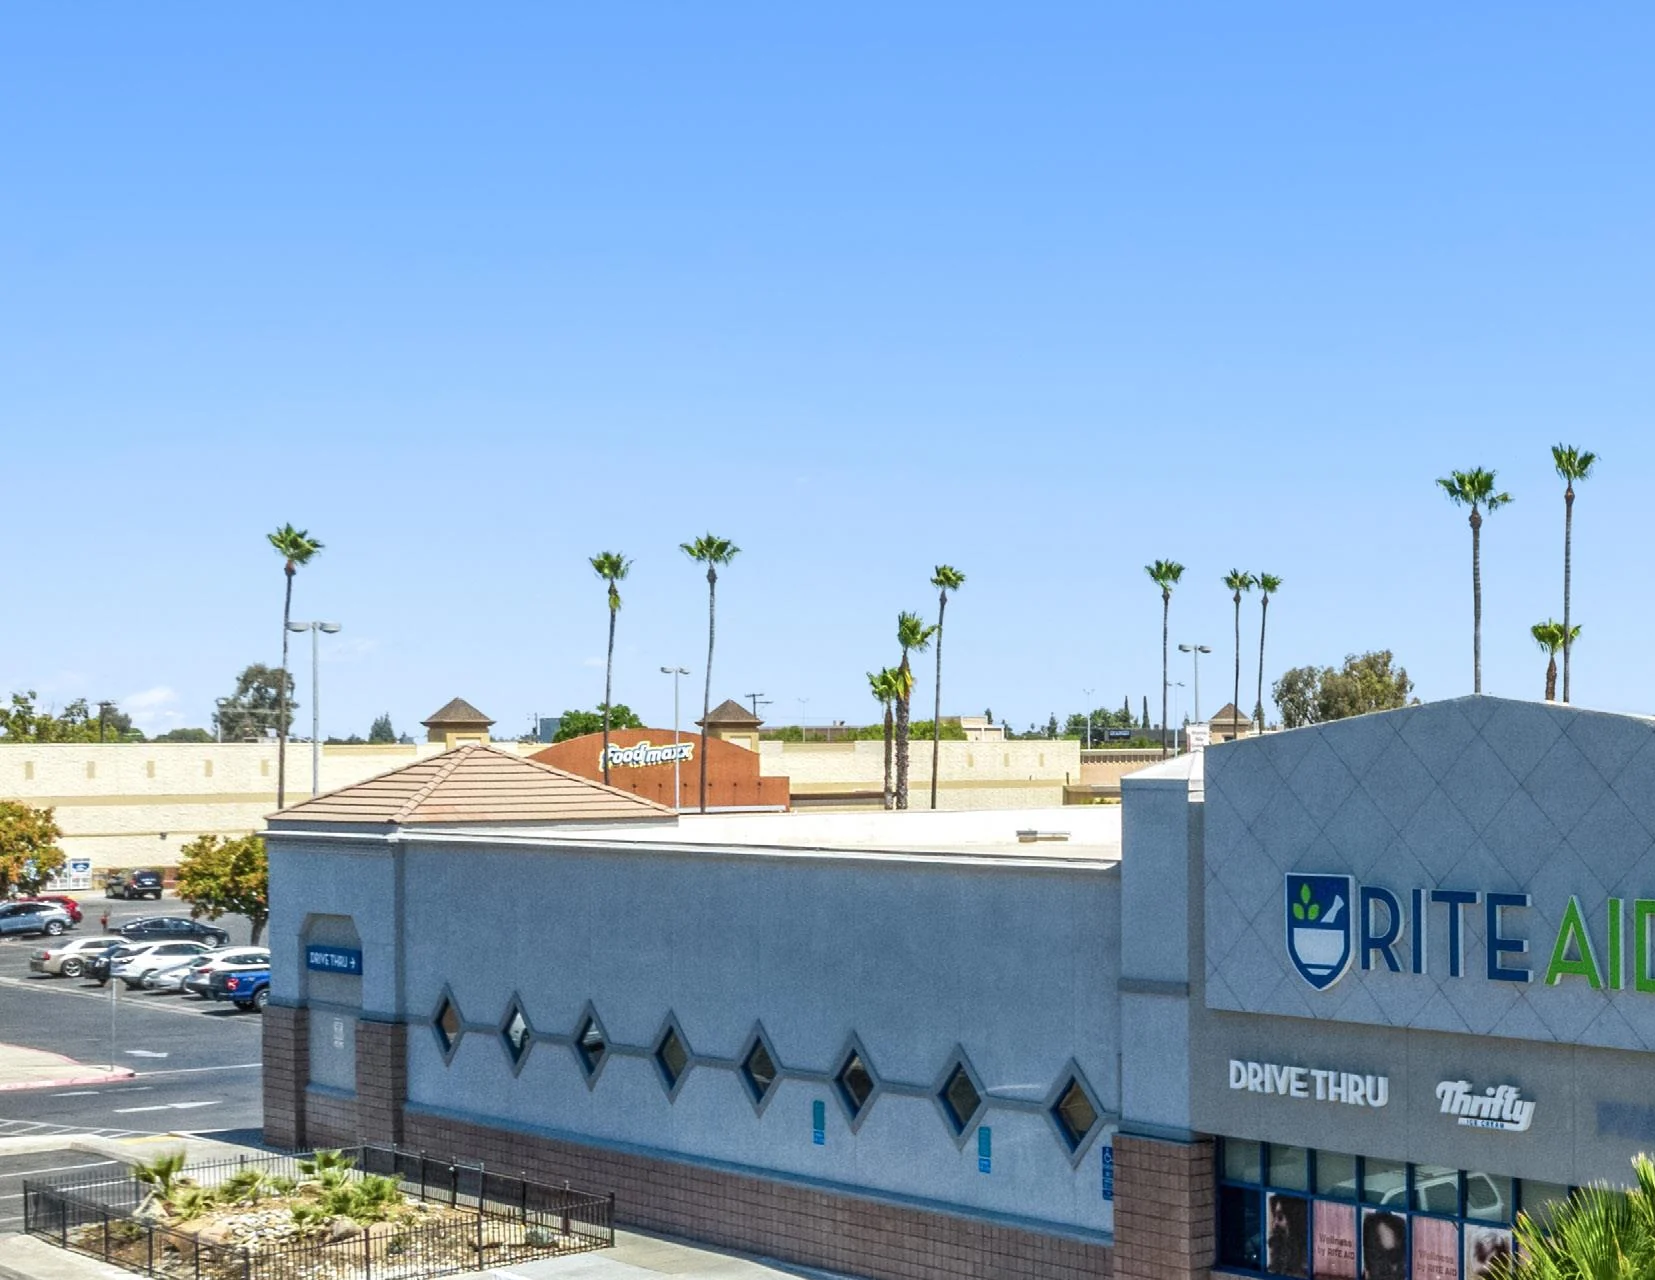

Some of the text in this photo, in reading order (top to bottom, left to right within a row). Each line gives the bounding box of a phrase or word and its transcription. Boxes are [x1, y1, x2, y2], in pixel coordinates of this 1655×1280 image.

[1359, 885, 1535, 984] RITE
[310, 951, 348, 968] DRIVE THRU
[1229, 1059, 1389, 1108] DRIVE THRU
[1436, 1080, 1537, 1132] Thrifty
[1318, 1232, 1353, 1247] Wellness
[1327, 1248, 1342, 1258] RITE
[1343, 1250, 1355, 1261] AID
[1427, 1264, 1444, 1275] RITE
